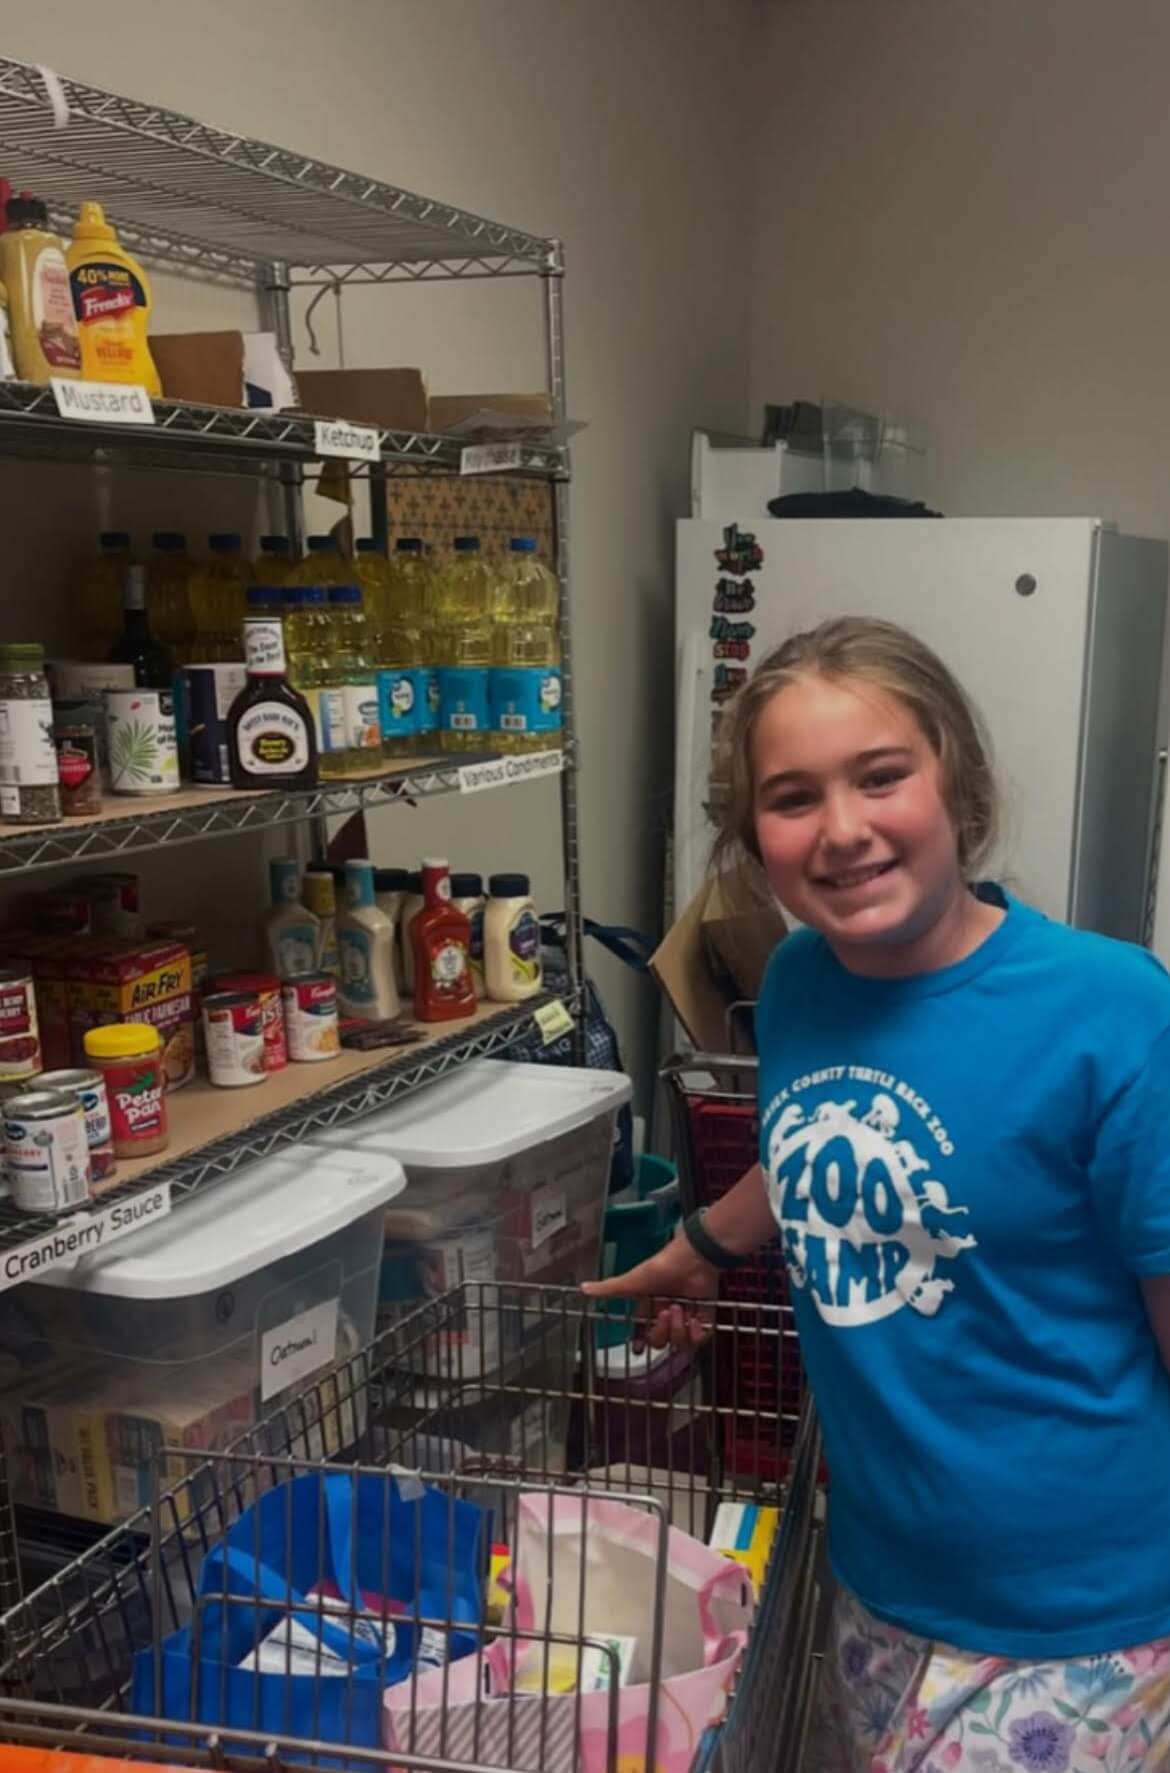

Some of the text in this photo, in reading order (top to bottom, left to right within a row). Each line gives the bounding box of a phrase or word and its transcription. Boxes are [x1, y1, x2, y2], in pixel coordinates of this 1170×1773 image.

[61, 384, 143, 413] Mustard
[321, 426, 374, 452] Ketchup
[463, 766, 505, 787] Various
[157, 969, 185, 996] FRY
[124, 1100, 162, 1124] Pan
[792, 1064, 847, 1093] COUNTY
[895, 1080, 932, 1119] BACK
[926, 1114, 955, 1157] ZOO
[777, 1134, 904, 1236] ZOO
[4, 1193, 163, 1279] Cranberry Sauce
[784, 1226, 910, 1308] CAMP
